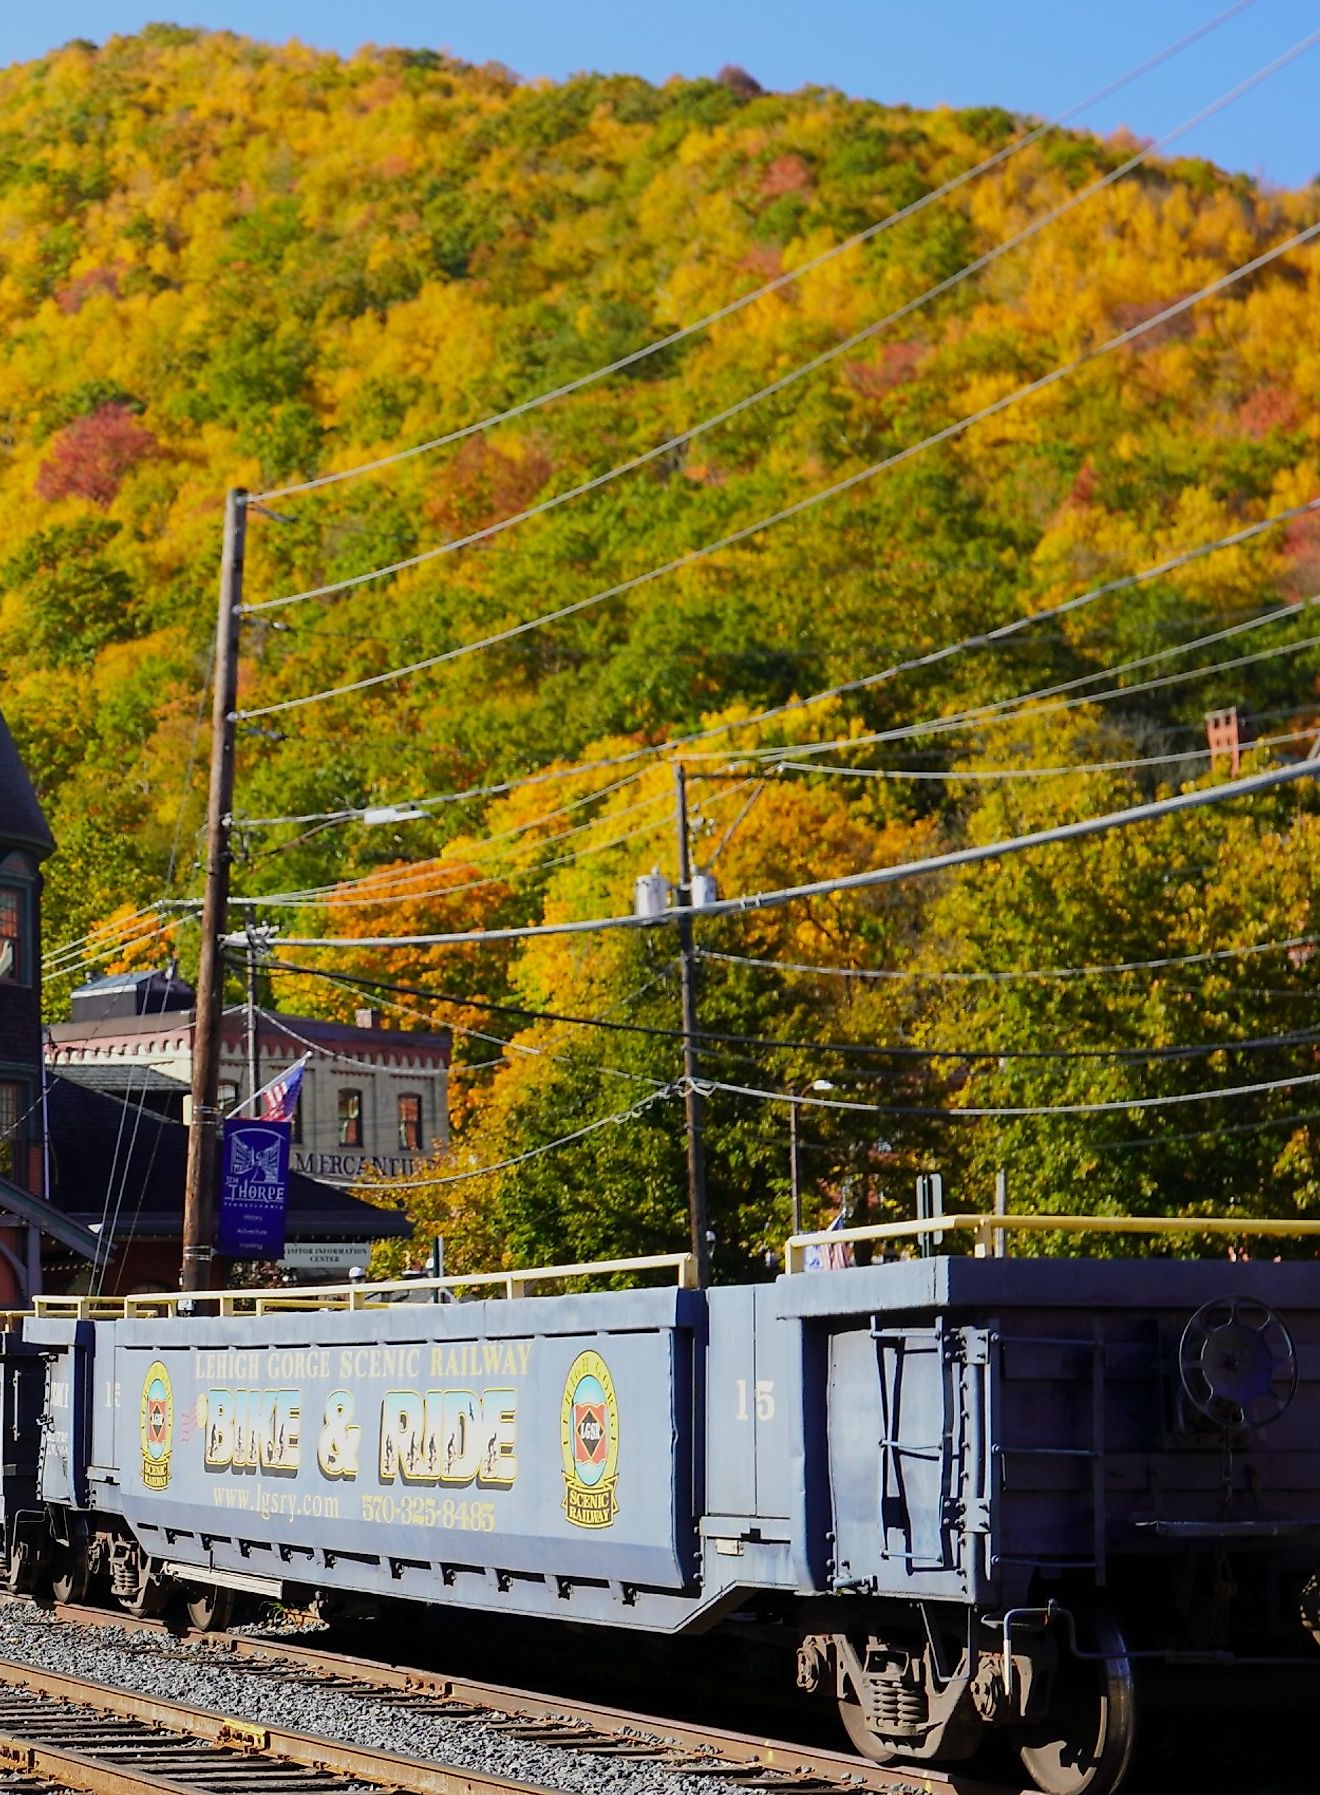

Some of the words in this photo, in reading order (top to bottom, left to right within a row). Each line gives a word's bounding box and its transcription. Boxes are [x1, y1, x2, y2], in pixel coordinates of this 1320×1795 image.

[295, 1153, 434, 1177] MERCANTIL
[228, 1179, 284, 1203] THORPE
[195, 1351, 260, 1379] LEHIGH
[267, 1350, 330, 1379] GORGE
[339, 1348, 420, 1378] SCENIC
[430, 1343, 533, 1377] RAILWAY
[736, 1379, 775, 1421] 15
[203, 1387, 301, 1479] BIKE
[317, 1389, 360, 1481] &
[379, 1387, 518, 1491] RIDE
[581, 1422, 601, 1441] LGSR
[212, 1483, 340, 1521] www.lgsry.com
[362, 1495, 496, 1533] 570-325-8485
[569, 1489, 609, 1508] SCENIC
[569, 1507, 610, 1524] RAILWAY
